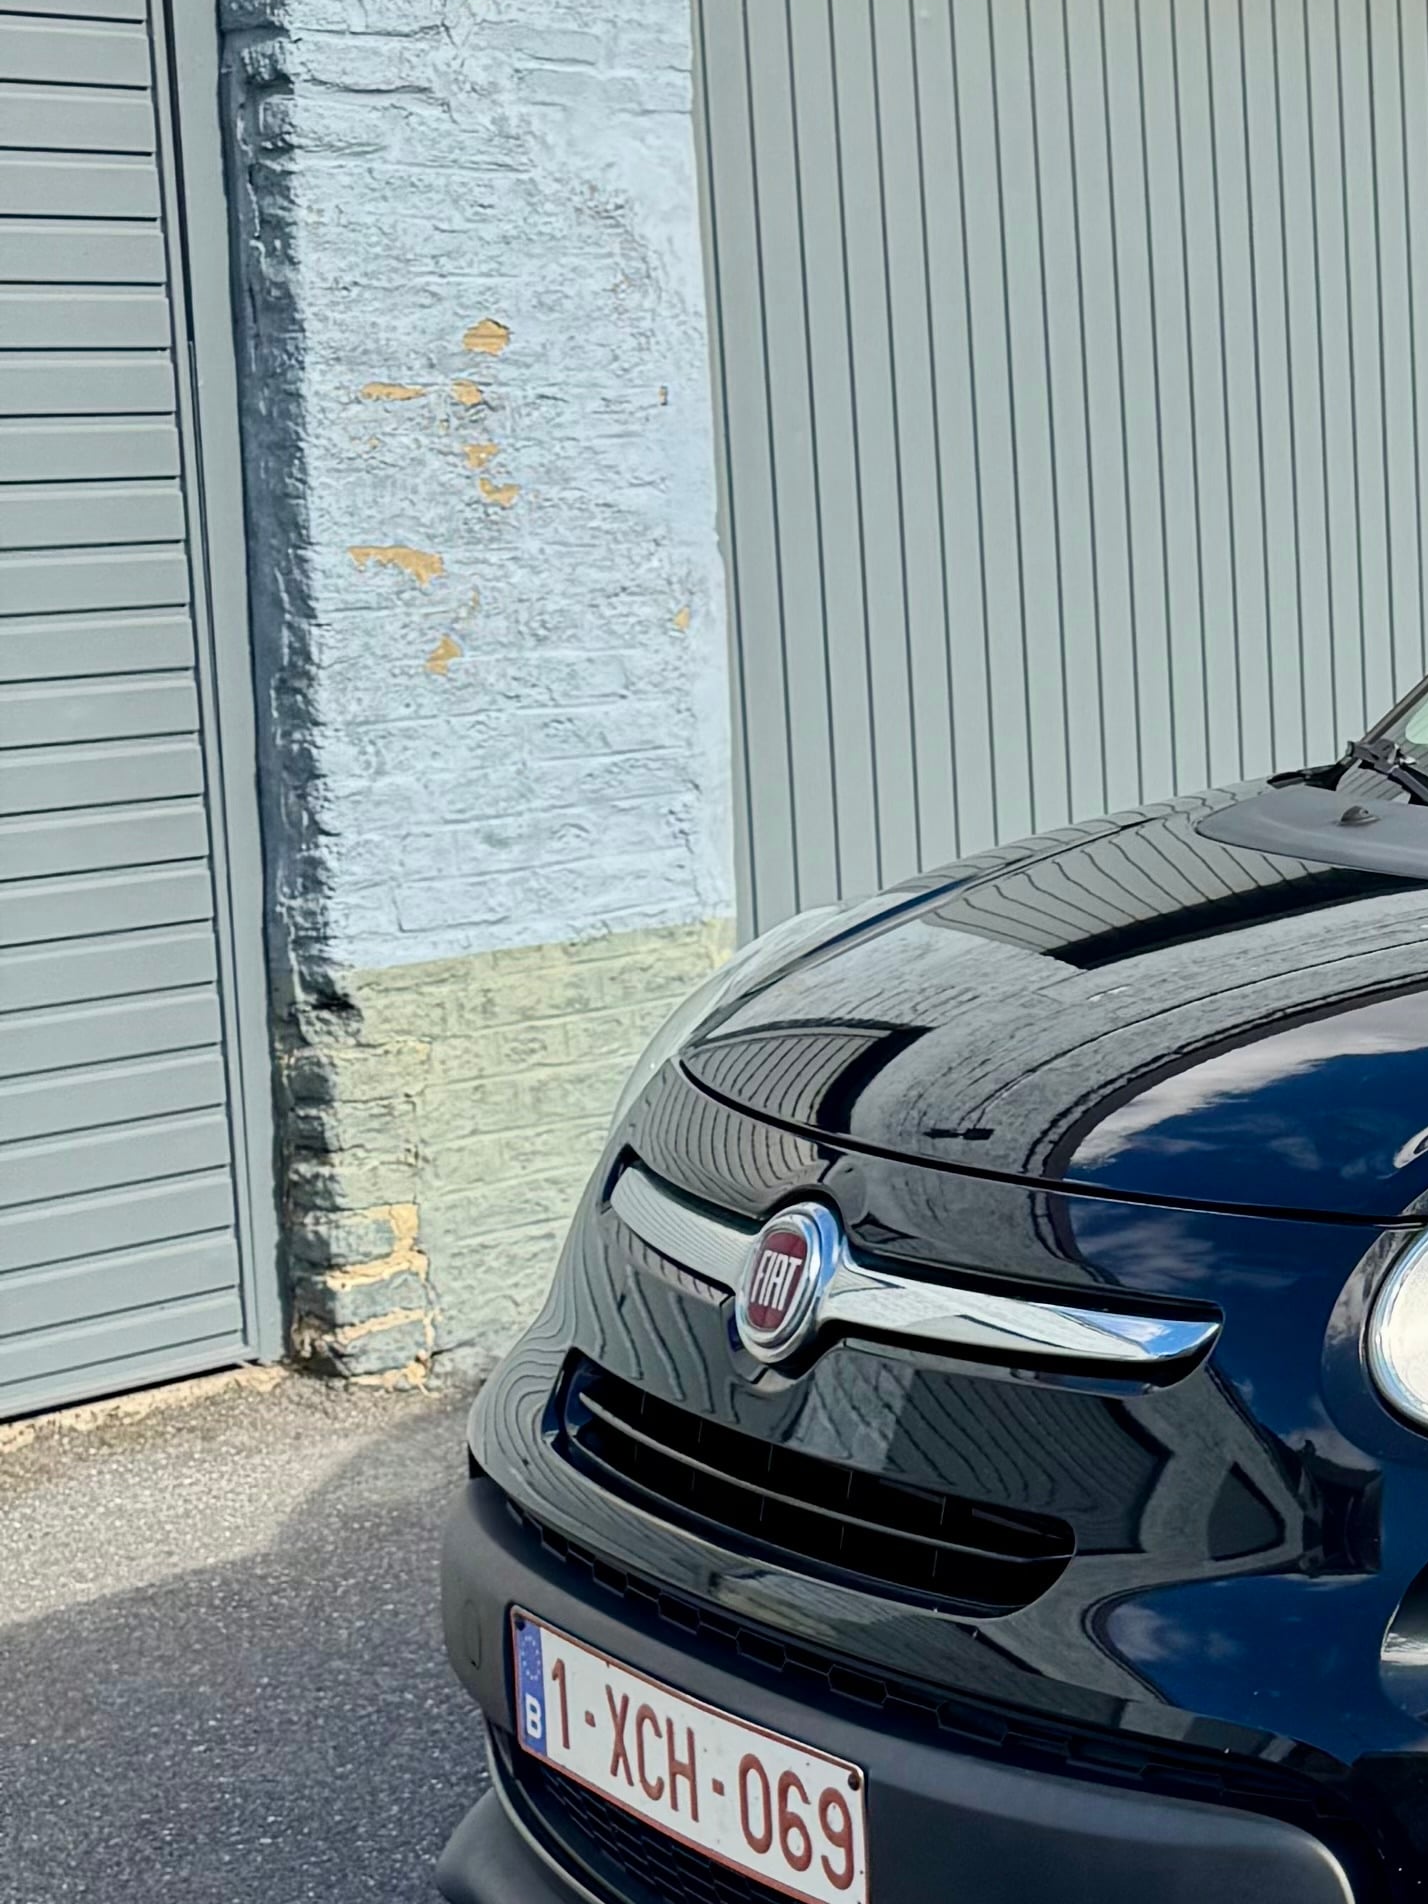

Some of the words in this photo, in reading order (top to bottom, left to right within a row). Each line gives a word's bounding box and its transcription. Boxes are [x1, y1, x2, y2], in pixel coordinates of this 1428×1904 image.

[751, 1250, 803, 1312] FIAT
[525, 1693, 542, 1740] B
[551, 1658, 855, 1891] 1-XCH-069
